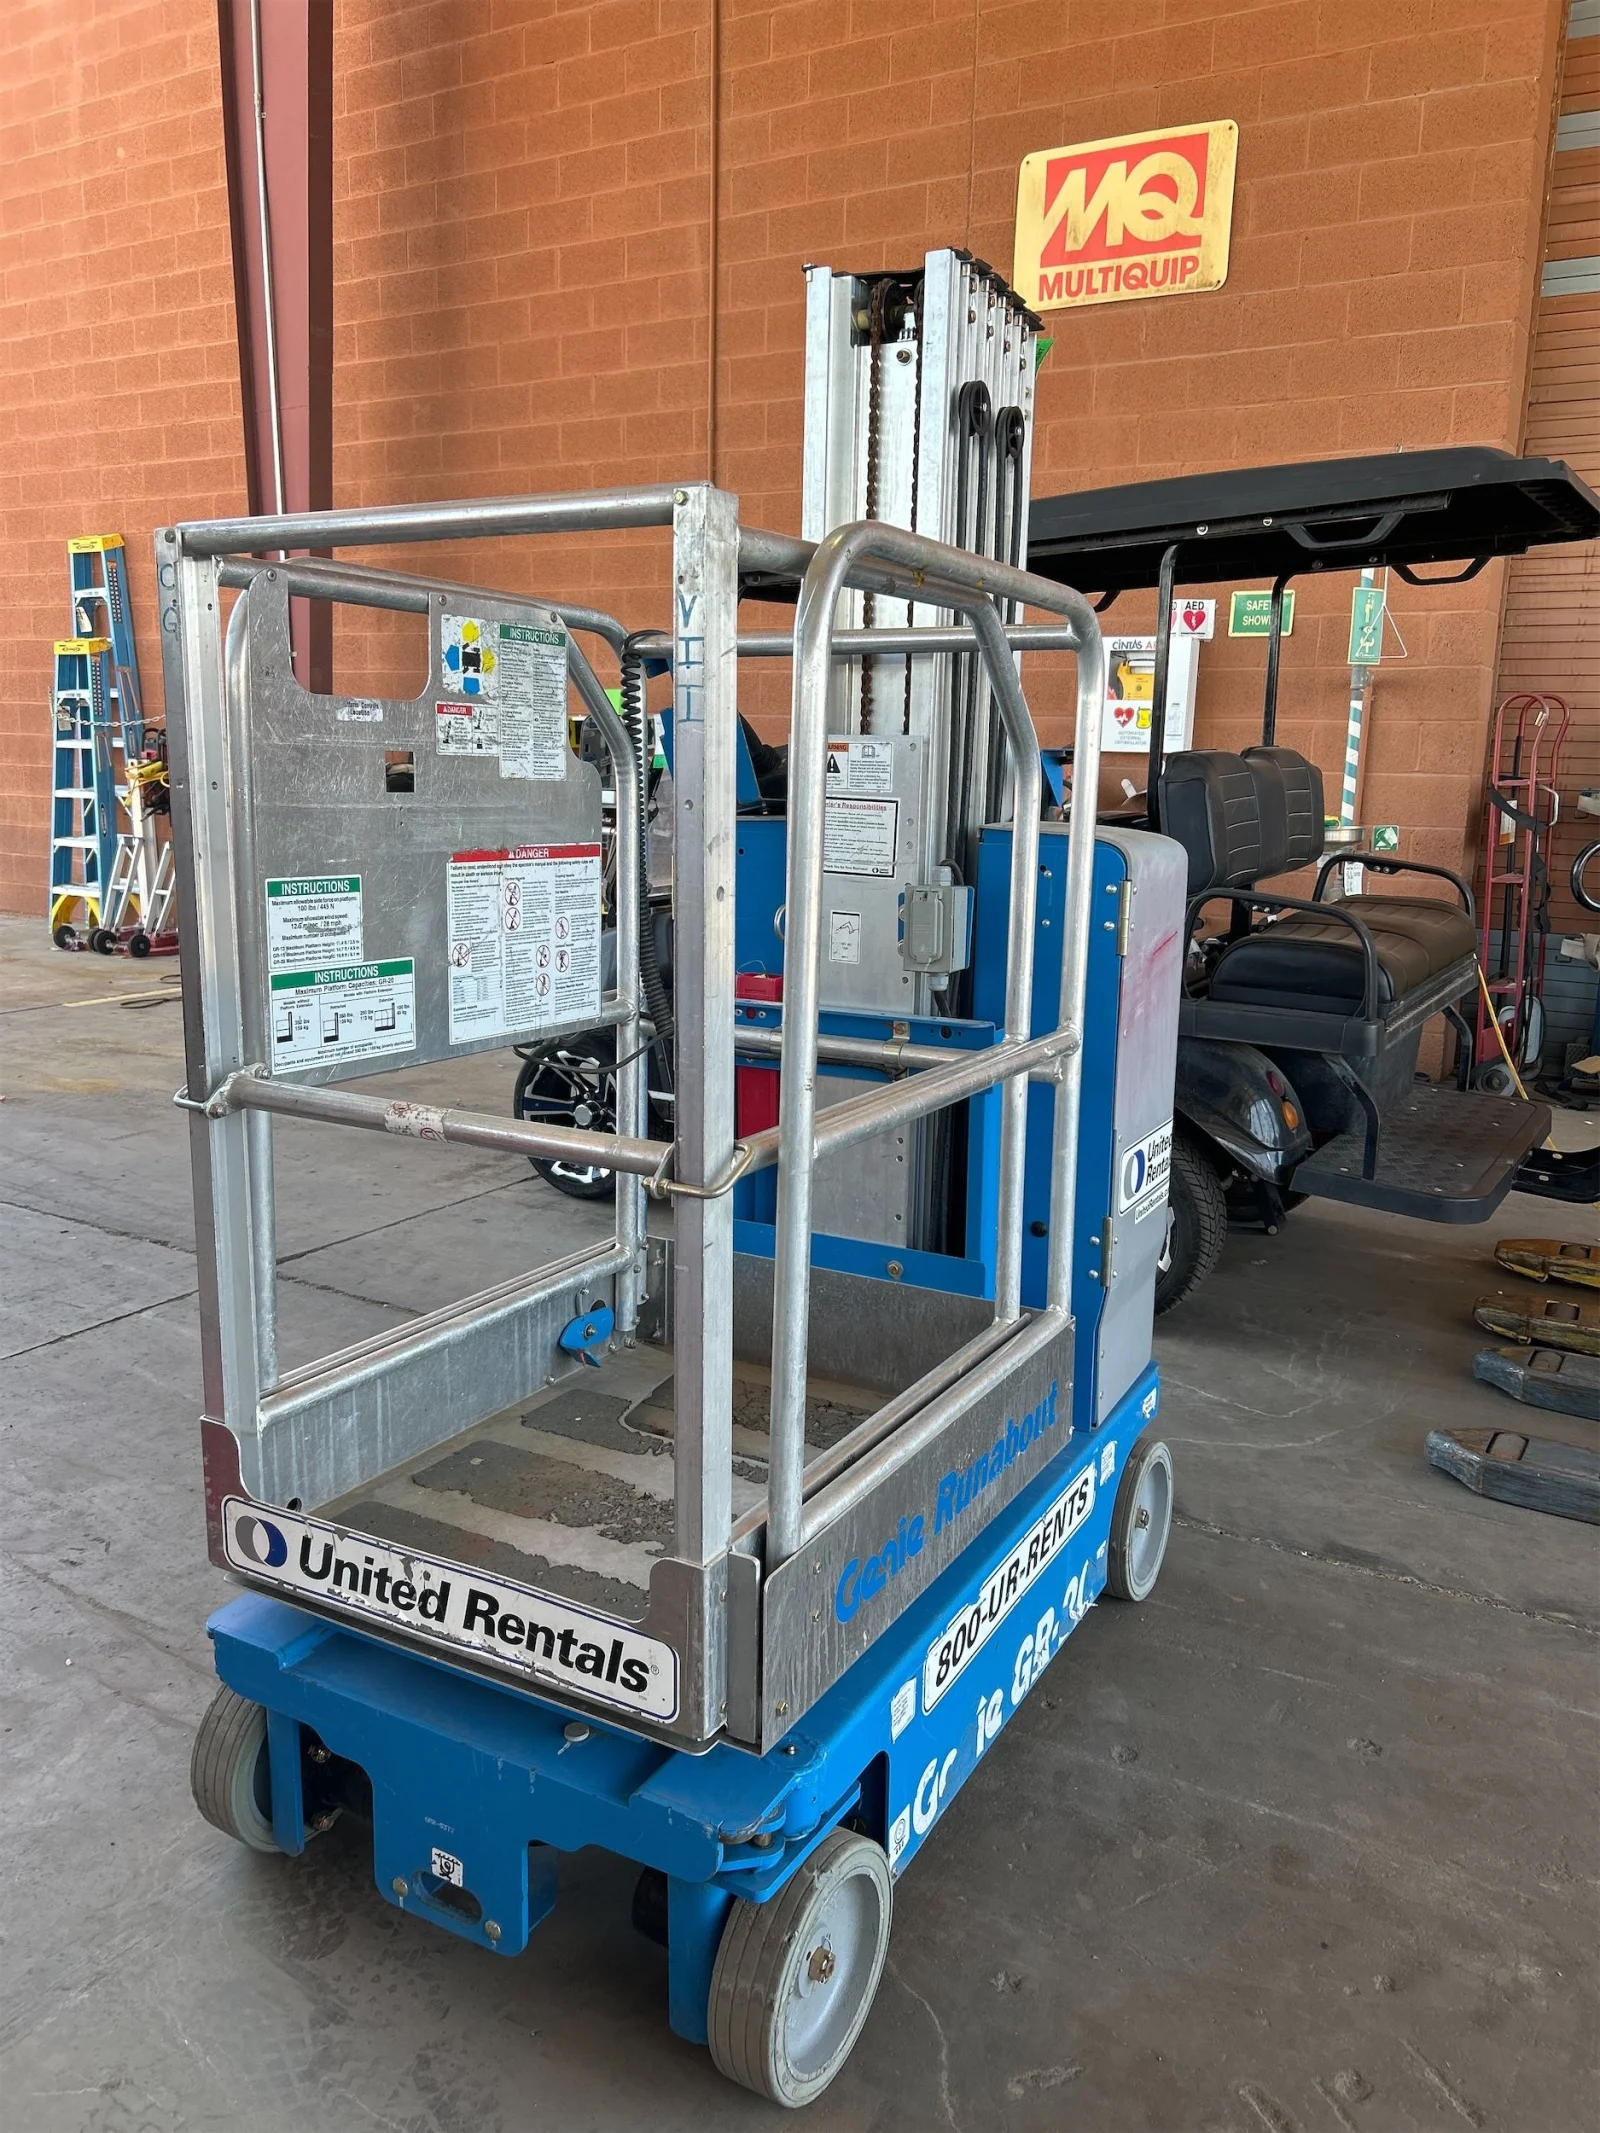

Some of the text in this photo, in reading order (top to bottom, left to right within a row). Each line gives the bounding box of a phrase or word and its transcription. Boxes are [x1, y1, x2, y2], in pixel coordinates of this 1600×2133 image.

[1042, 151, 1205, 252] MQ
[1039, 255, 1199, 301] MULTIQUIP
[1185, 601, 1204, 610] AED
[1246, 600, 1271, 610] SAFET
[1243, 615, 1270, 626] SHOW
[509, 627, 559, 644] INSTRUCTIONS
[842, 803, 887, 812] Responsibilities
[516, 848, 549, 858] DANGER
[282, 880, 350, 895] INSTRUCTIONS
[314, 965, 379, 984] INSTRUCTIONS
[295, 987, 322, 995] Maximum
[324, 984, 347, 992] Platform
[348, 980, 377, 990] Capacities:
[834, 1379, 1059, 1625] Genie Runabout
[935, 1476, 1090, 1688] 800-UR-RENTS
[299, 1533, 650, 1694] United Rentals
